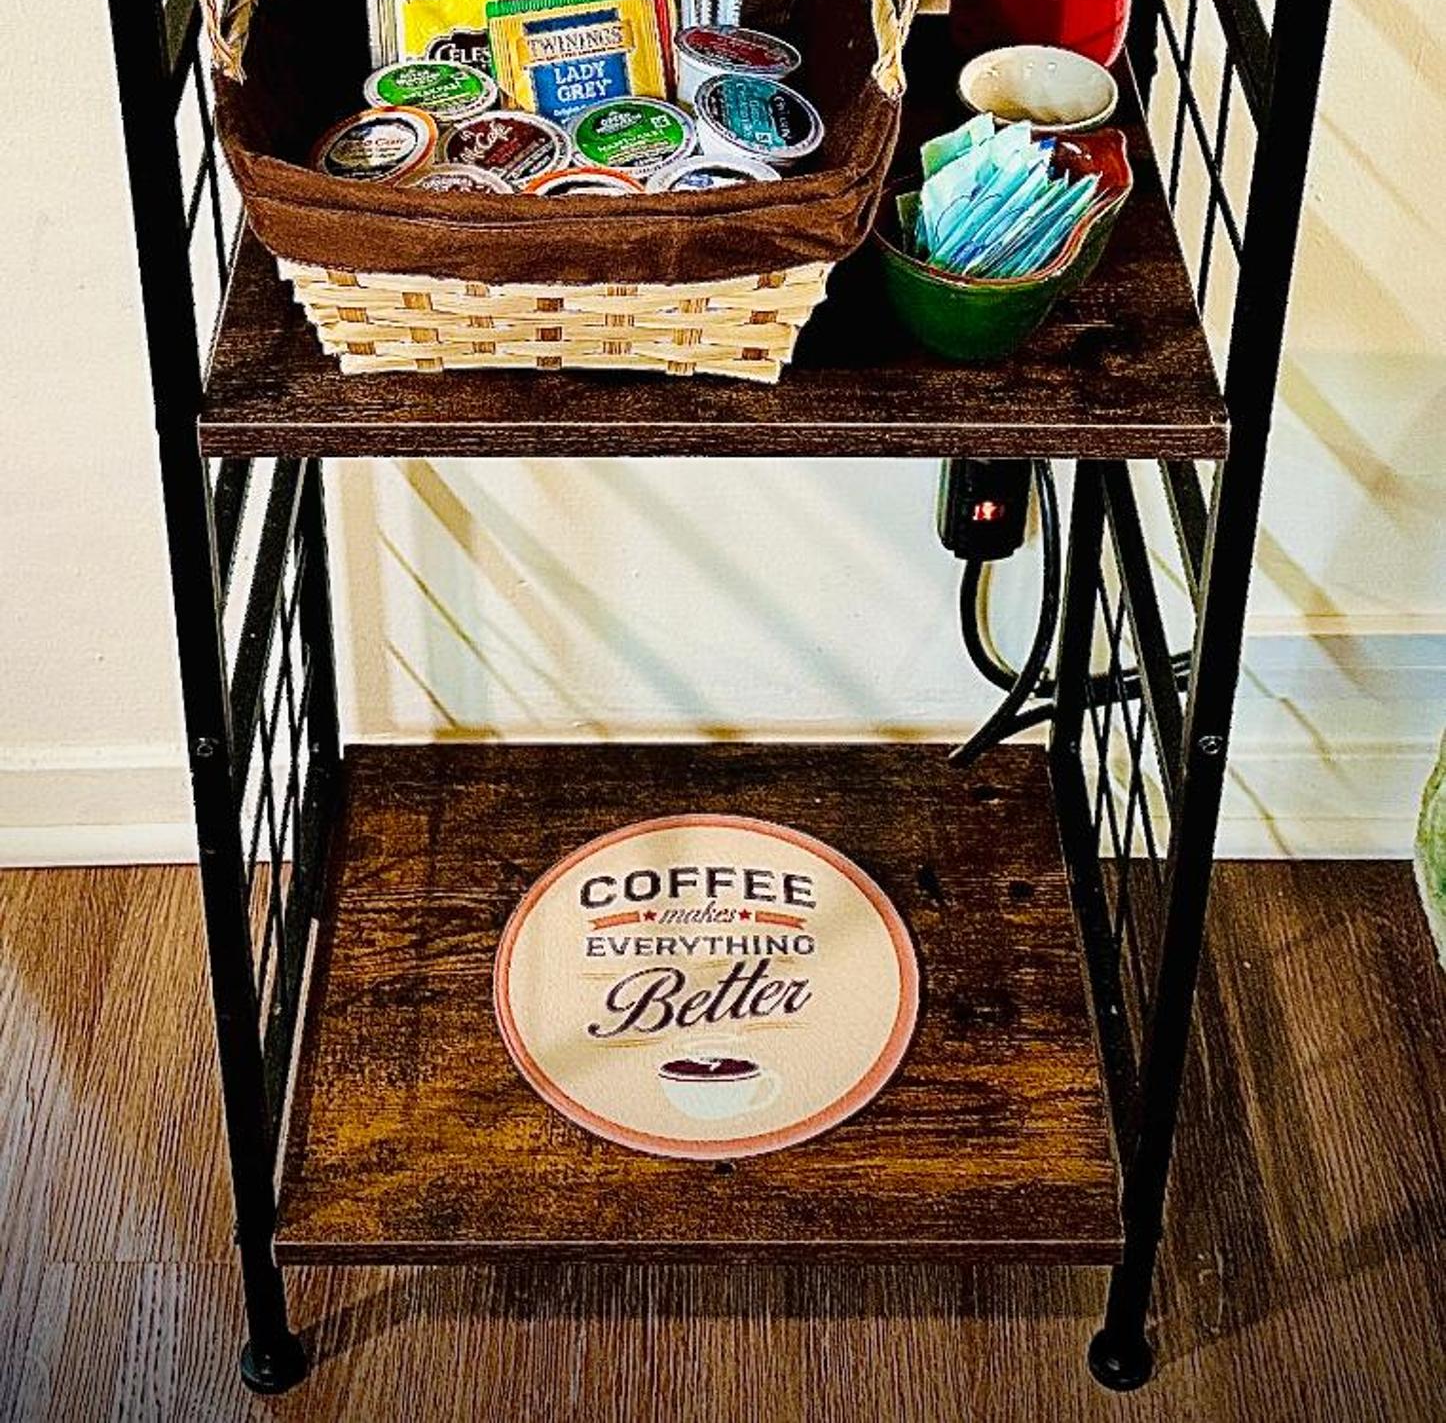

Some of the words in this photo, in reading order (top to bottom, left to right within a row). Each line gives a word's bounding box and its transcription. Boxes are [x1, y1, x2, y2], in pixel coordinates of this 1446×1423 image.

[529, 26, 624, 56] TWININGS
[553, 60, 607, 86] LADY
[557, 77, 612, 102] GREY
[578, 866, 818, 910] COFFEE
[657, 899, 737, 926] makes
[584, 933, 817, 958] EVERYTHING
[587, 958, 813, 1039] Better
